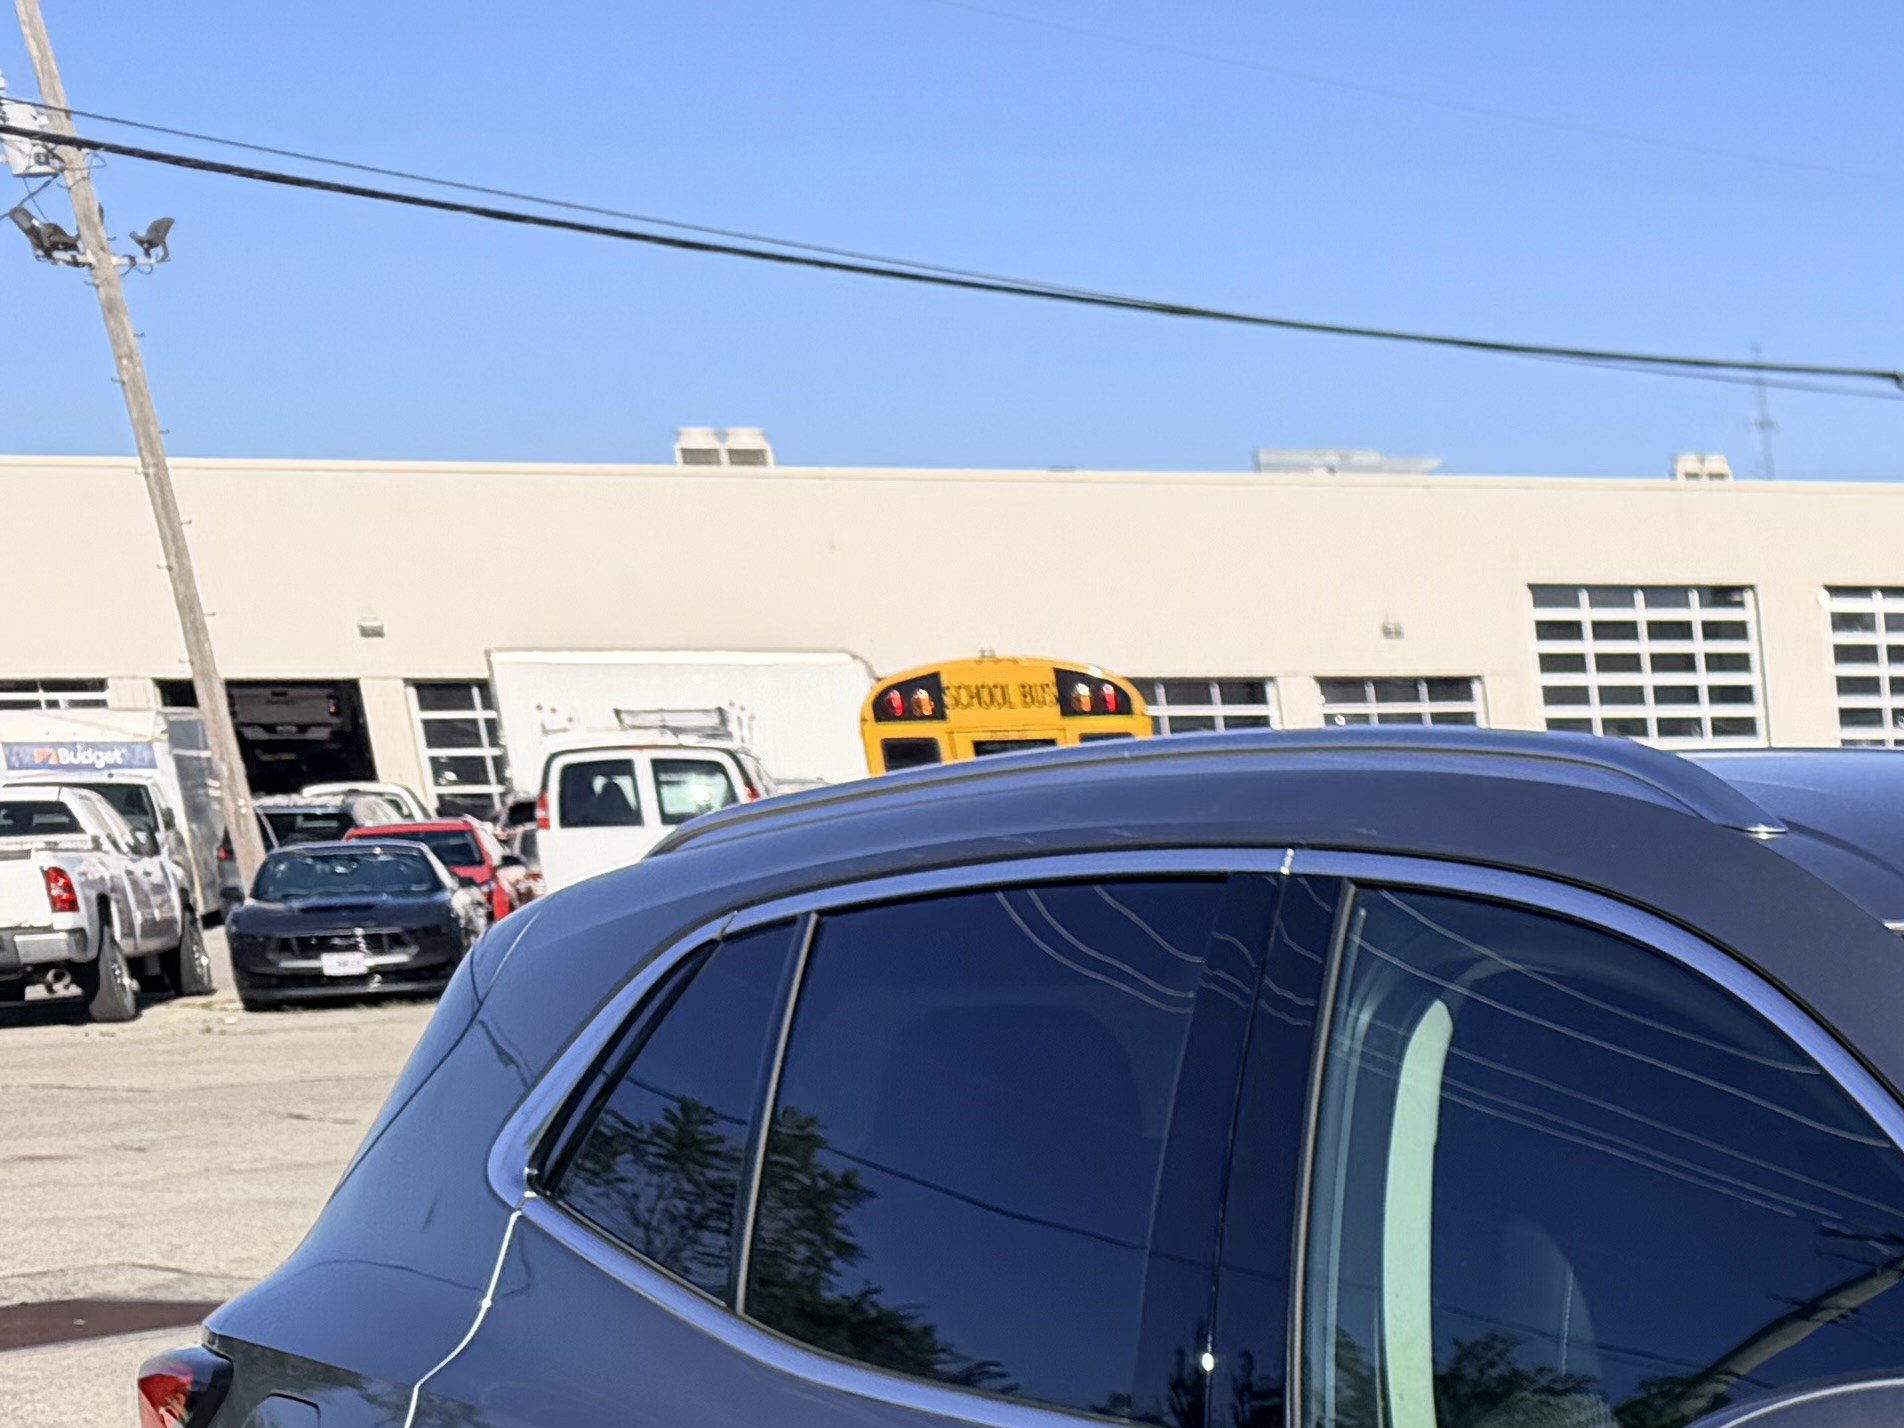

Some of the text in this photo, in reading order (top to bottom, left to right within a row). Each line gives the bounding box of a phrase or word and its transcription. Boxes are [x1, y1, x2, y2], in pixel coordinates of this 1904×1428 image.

[943, 682, 1059, 710] SCHOOL BUS
[57, 744, 123, 769] Budget
